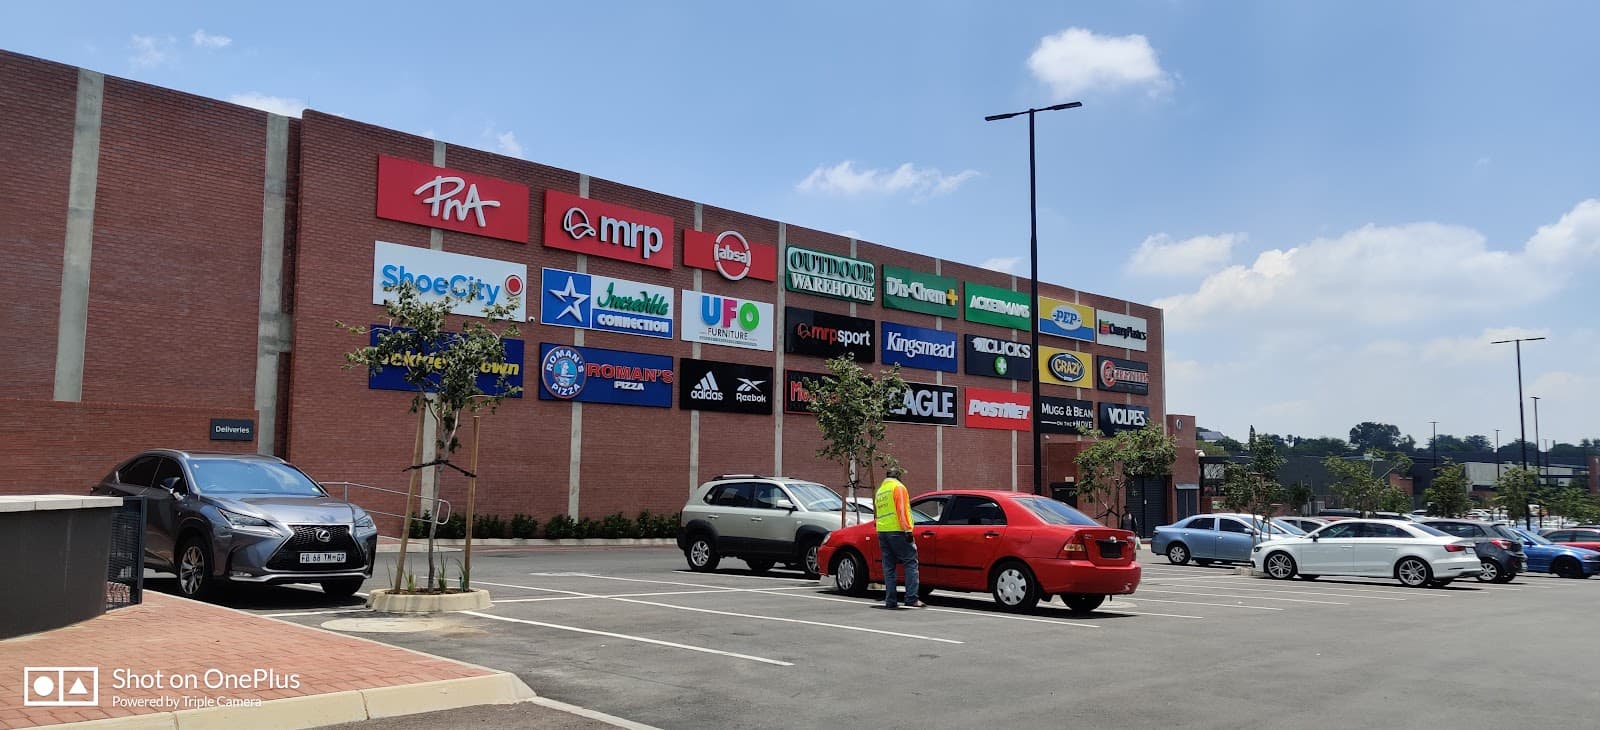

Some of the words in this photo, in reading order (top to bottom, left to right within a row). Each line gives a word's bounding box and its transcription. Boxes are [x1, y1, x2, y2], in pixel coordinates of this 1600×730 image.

[600, 215, 663, 258] mrp
[718, 244, 746, 262] absa
[790, 251, 874, 284] OUTDOOR
[382, 264, 500, 305] ShoeCity
[790, 272, 875, 302] WAREHOUSE
[597, 282, 669, 315] Incredible
[969, 295, 1030, 318] ACKERMANS
[597, 313, 669, 333] CONNECTION
[701, 295, 759, 331] UFO
[707, 327, 749, 340] FURNITURE
[887, 331, 955, 359] Kingsmead
[986, 338, 1031, 358] CLICKS
[546, 349, 585, 372] ROMAN'S
[586, 363, 674, 383] ROMAN'S
[551, 383, 580, 396] PIZZA
[613, 381, 645, 391] PIZZA
[690, 389, 724, 401] adidas
[736, 392, 766, 403] Reebok
[1065, 405, 1073, 417] &
[1073, 406, 1093, 418] BEAN
[1108, 407, 1146, 427] VOLPES
[215, 425, 250, 434] Deliveries
